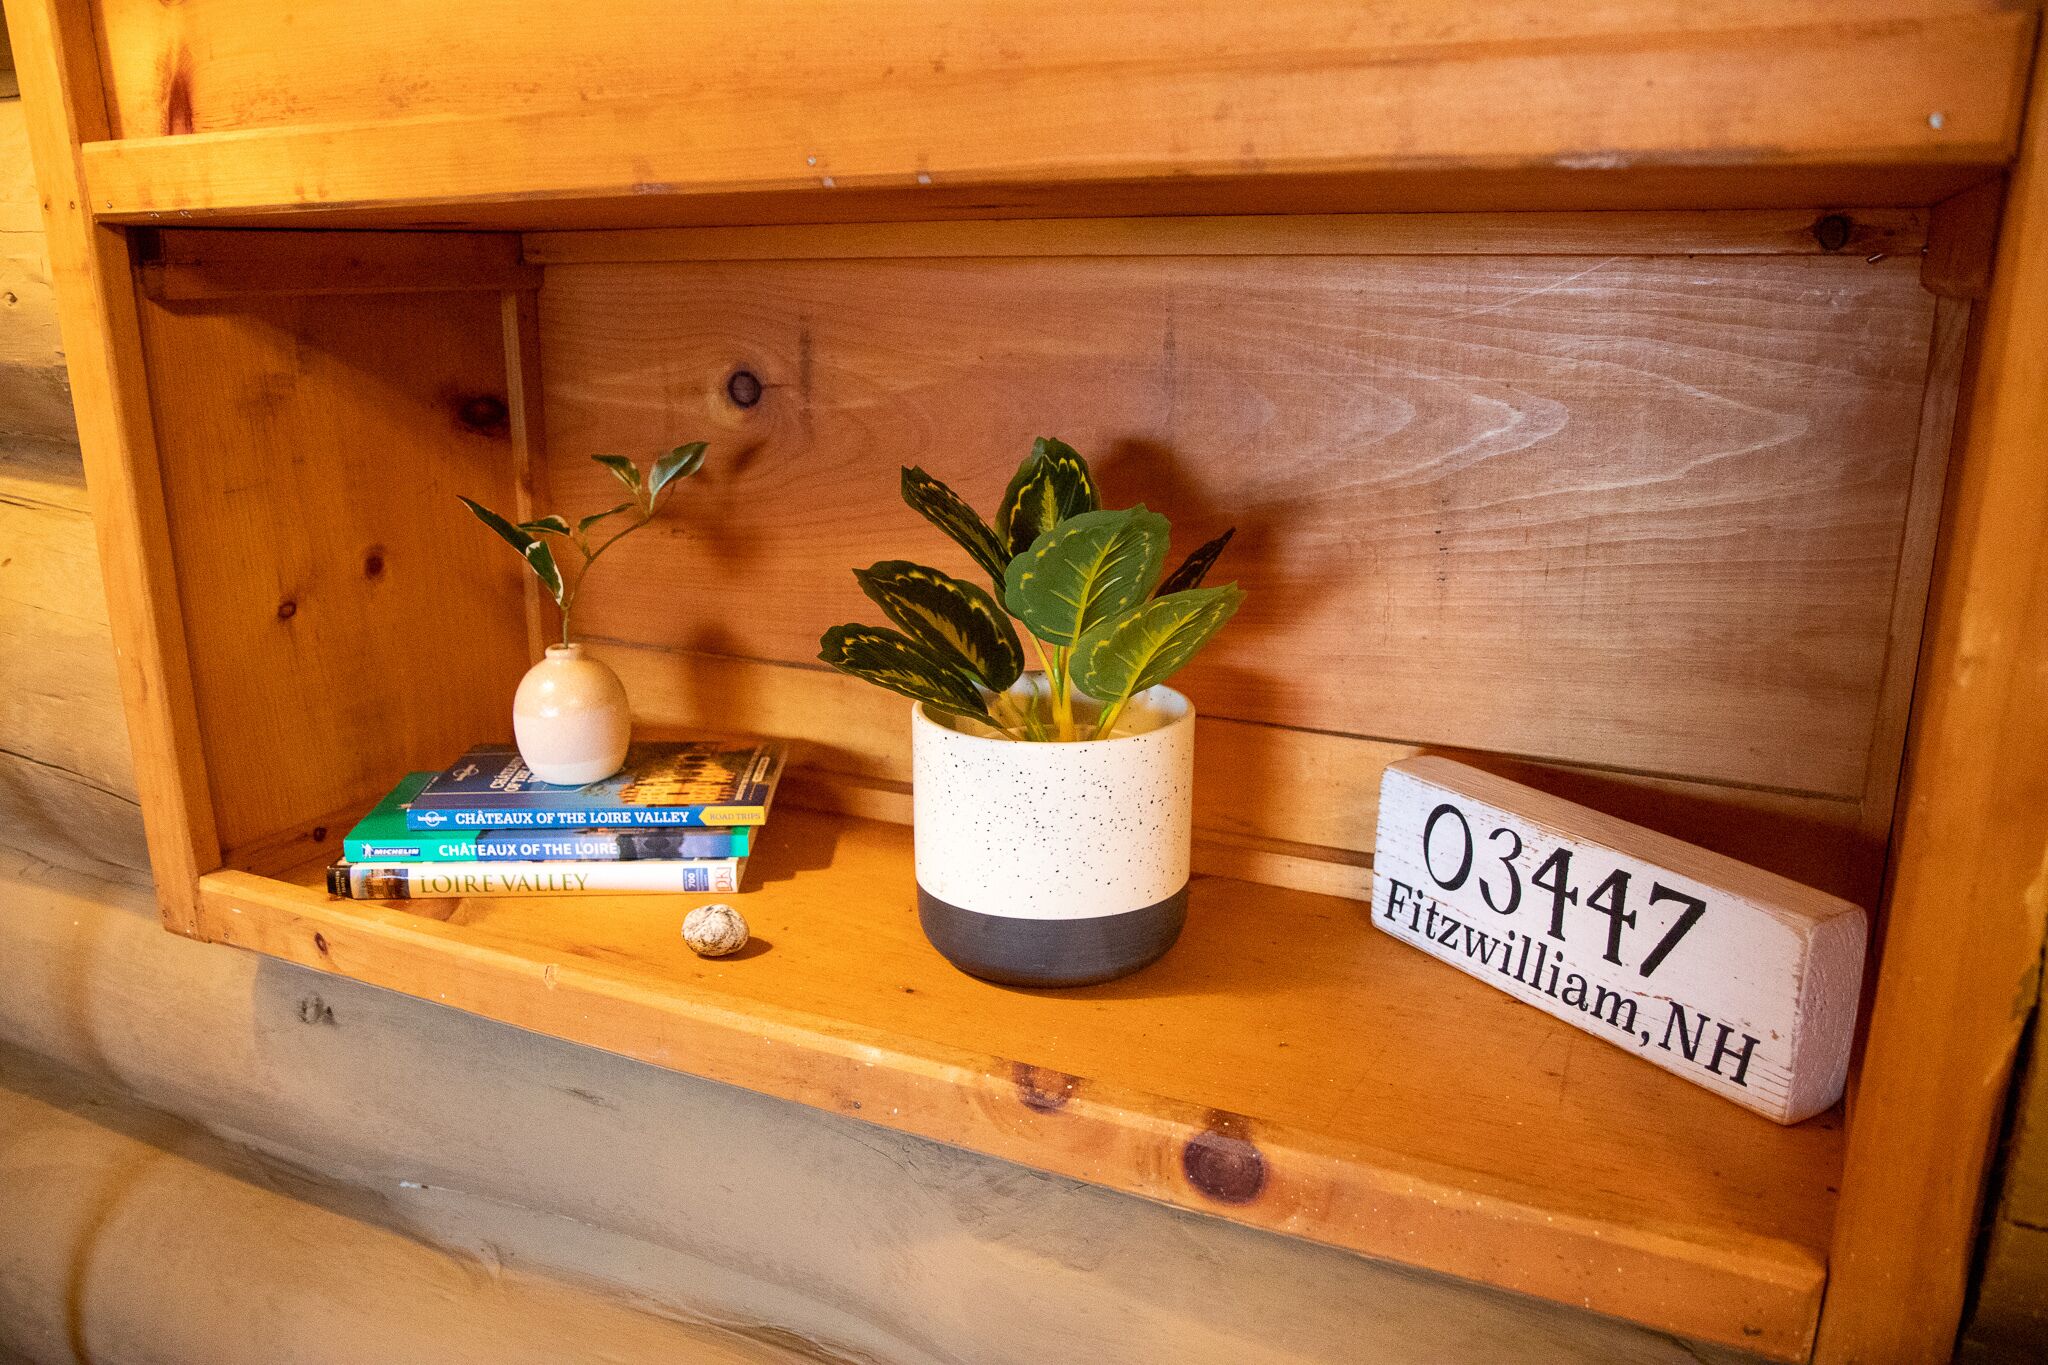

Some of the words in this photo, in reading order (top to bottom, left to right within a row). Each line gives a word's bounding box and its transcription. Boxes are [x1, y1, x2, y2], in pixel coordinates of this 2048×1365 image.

[455, 810, 533, 825] CHÂTEAUX
[536, 812, 556, 824] OF
[558, 812, 587, 823] THE
[590, 812, 631, 823] LOIRE
[634, 811, 689, 823] VALLEY
[709, 812, 734, 821] ROAD
[736, 812, 761, 821] TRIPS
[374, 847, 419, 855] MICHELIN
[438, 842, 517, 857] CHÂTEAUX
[521, 844, 540, 856] OF
[543, 843, 572, 856] THE
[575, 842, 618, 855] LOIRE
[421, 874, 494, 894] LOIRE
[500, 873, 589, 893] VALLEY
[687, 872, 696, 888] 700
[1423, 803, 1707, 978] 03447
